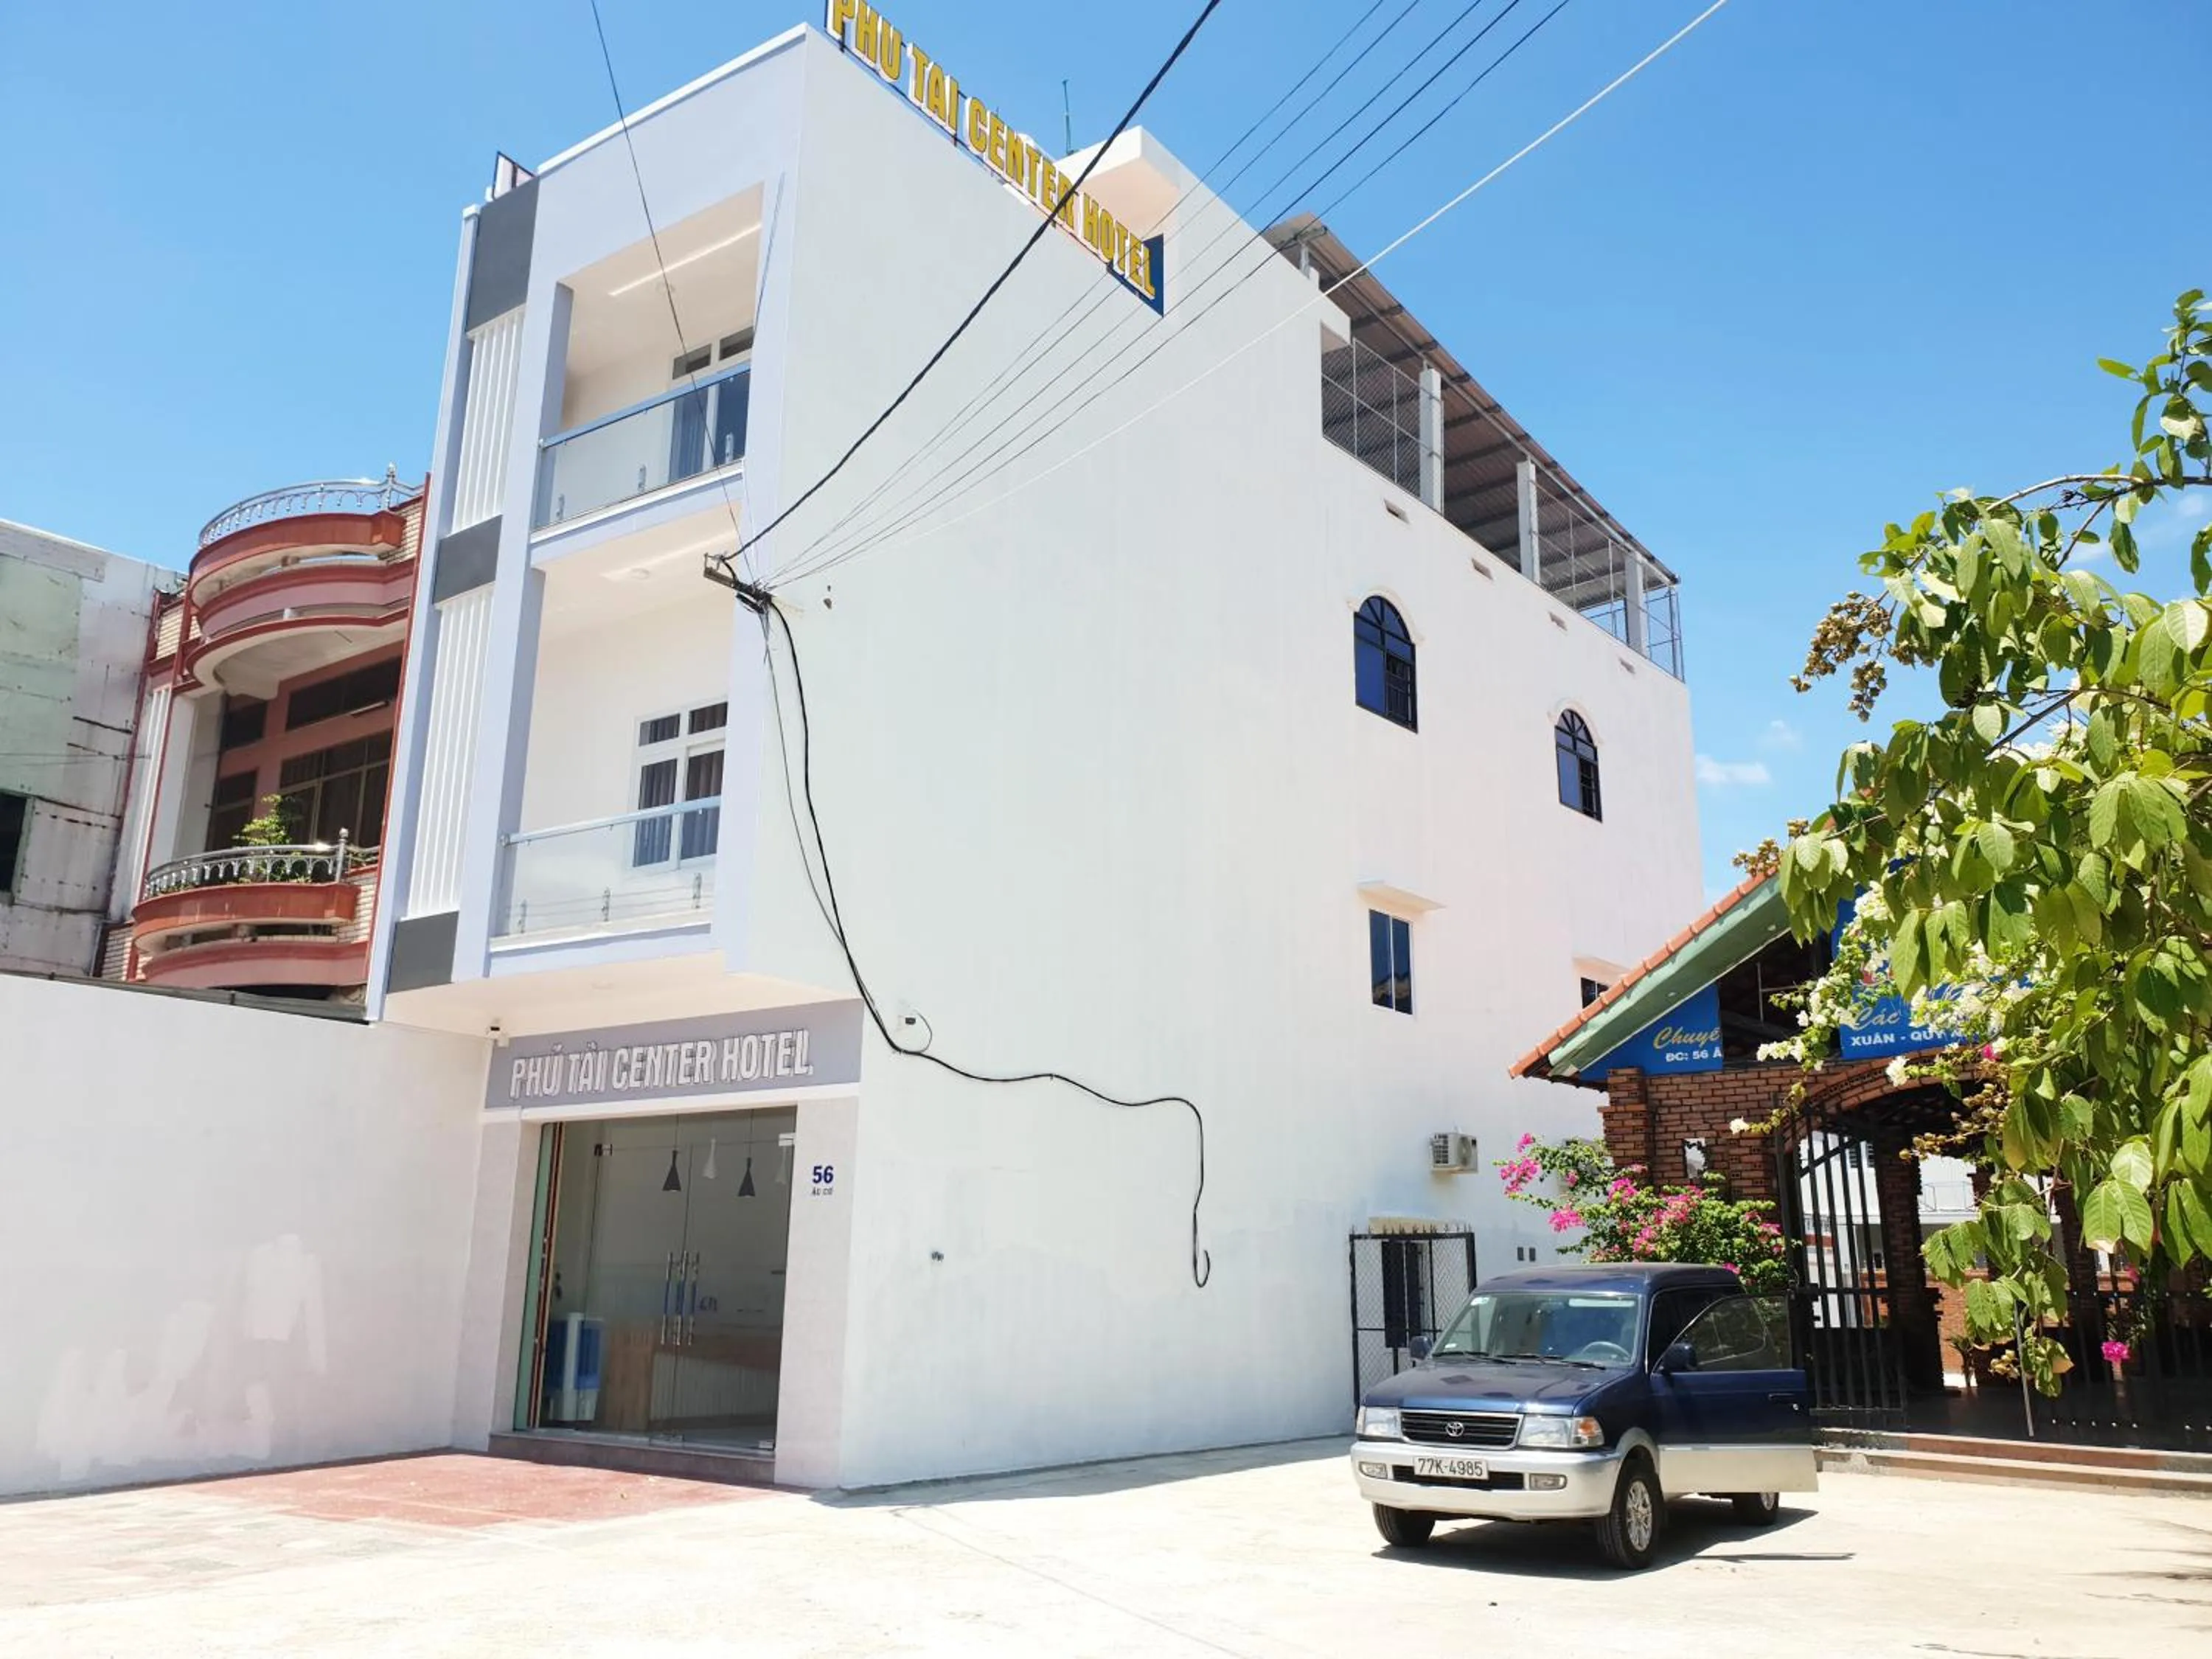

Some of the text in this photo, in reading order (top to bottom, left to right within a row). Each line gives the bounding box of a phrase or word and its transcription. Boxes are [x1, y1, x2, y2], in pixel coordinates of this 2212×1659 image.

[908, 42, 959, 136] TAI
[963, 97, 1075, 232] CENTER
[1078, 192, 1155, 300] HOTEL
[1851, 1032, 1895, 1046] XUÂN
[1693, 1049, 1708, 1060] 56
[509, 1029, 813, 1099] PHÚ TÀI CENTER HOTEL
[813, 1166, 833, 1183] 56
[1418, 1458, 1483, 1477] 77K-4985
